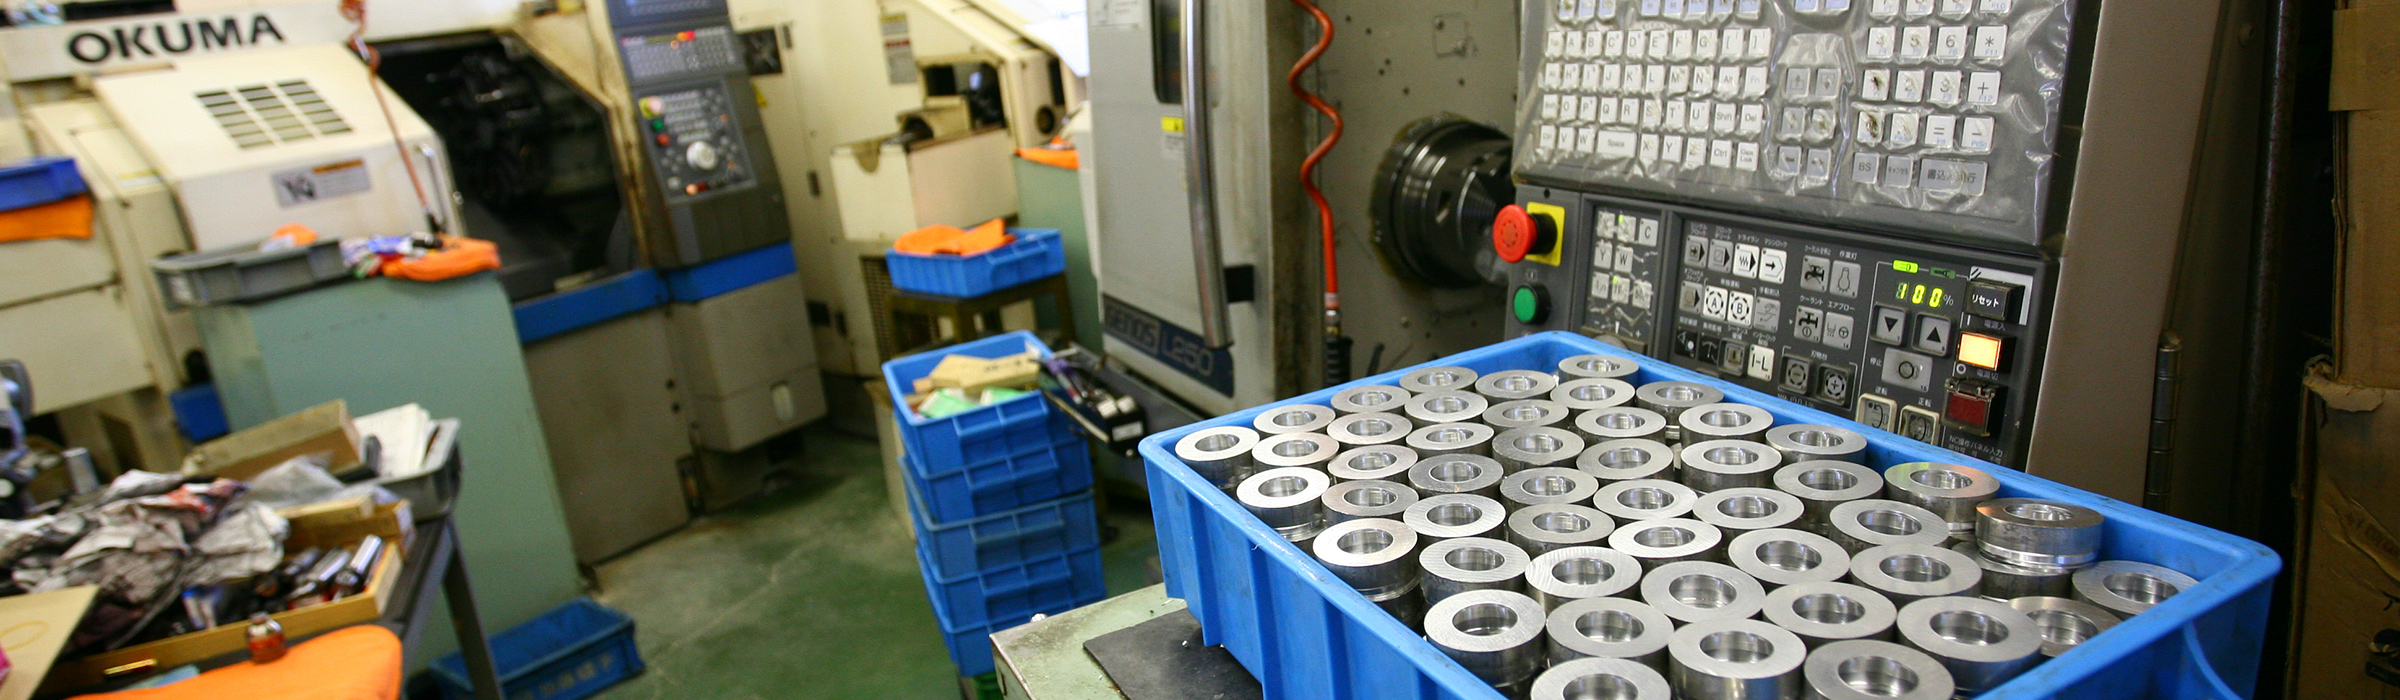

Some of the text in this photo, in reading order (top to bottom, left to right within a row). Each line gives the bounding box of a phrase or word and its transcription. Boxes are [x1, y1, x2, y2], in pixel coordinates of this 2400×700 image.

[68, 15, 284, 63] OKUMA
[1569, 38, 1575, 47] A
[1588, 38, 1594, 47] B
[1608, 37, 1615, 47] C
[1629, 38, 1636, 47] D
[1652, 36, 1658, 47] E
[1700, 36, 1707, 47] G
[1753, 36, 1757, 48] ]
[1946, 34, 1956, 48] 6
[1566, 71, 1572, 79] H
[1606, 71, 1612, 81] J
[1627, 71, 1633, 81] K
[1649, 72, 1655, 82] L
[1671, 72, 1679, 83] M
[1696, 72, 1704, 83] N
[1940, 77, 1950, 92] 3
[1583, 103, 1589, 112] P
[1603, 104, 1610, 114] Q
[1624, 104, 1630, 114] R
[1670, 107, 1676, 118] T
[1693, 109, 1699, 120] U
[1717, 112, 1733, 121] Shift
[1745, 113, 1758, 121] Del
[1561, 134, 1567, 143] V
[1580, 135, 1588, 145] W
[1607, 138, 1625, 147] Space
[1643, 140, 1650, 151] X
[1665, 142, 1672, 153] Y
[1714, 149, 1727, 158] Ctrl
[1858, 163, 1871, 172] BS
[1644, 226, 1652, 239] C
[1600, 249, 1606, 261] Y
[1619, 253, 1628, 266] W
[1839, 250, 1858, 260] 作業灯
[1711, 298, 1718, 309] A
[1799, 295, 1824, 305] クーラント
[1827, 300, 1856, 311] エアブロー
[1972, 293, 1999, 308] リセット
[1736, 303, 1742, 314] B
[1161, 332, 1213, 377] L250
[1870, 357, 1882, 367] 停止
[1918, 396, 1932, 408] 正転
[1949, 434, 2003, 458] NC操作パネル入力
